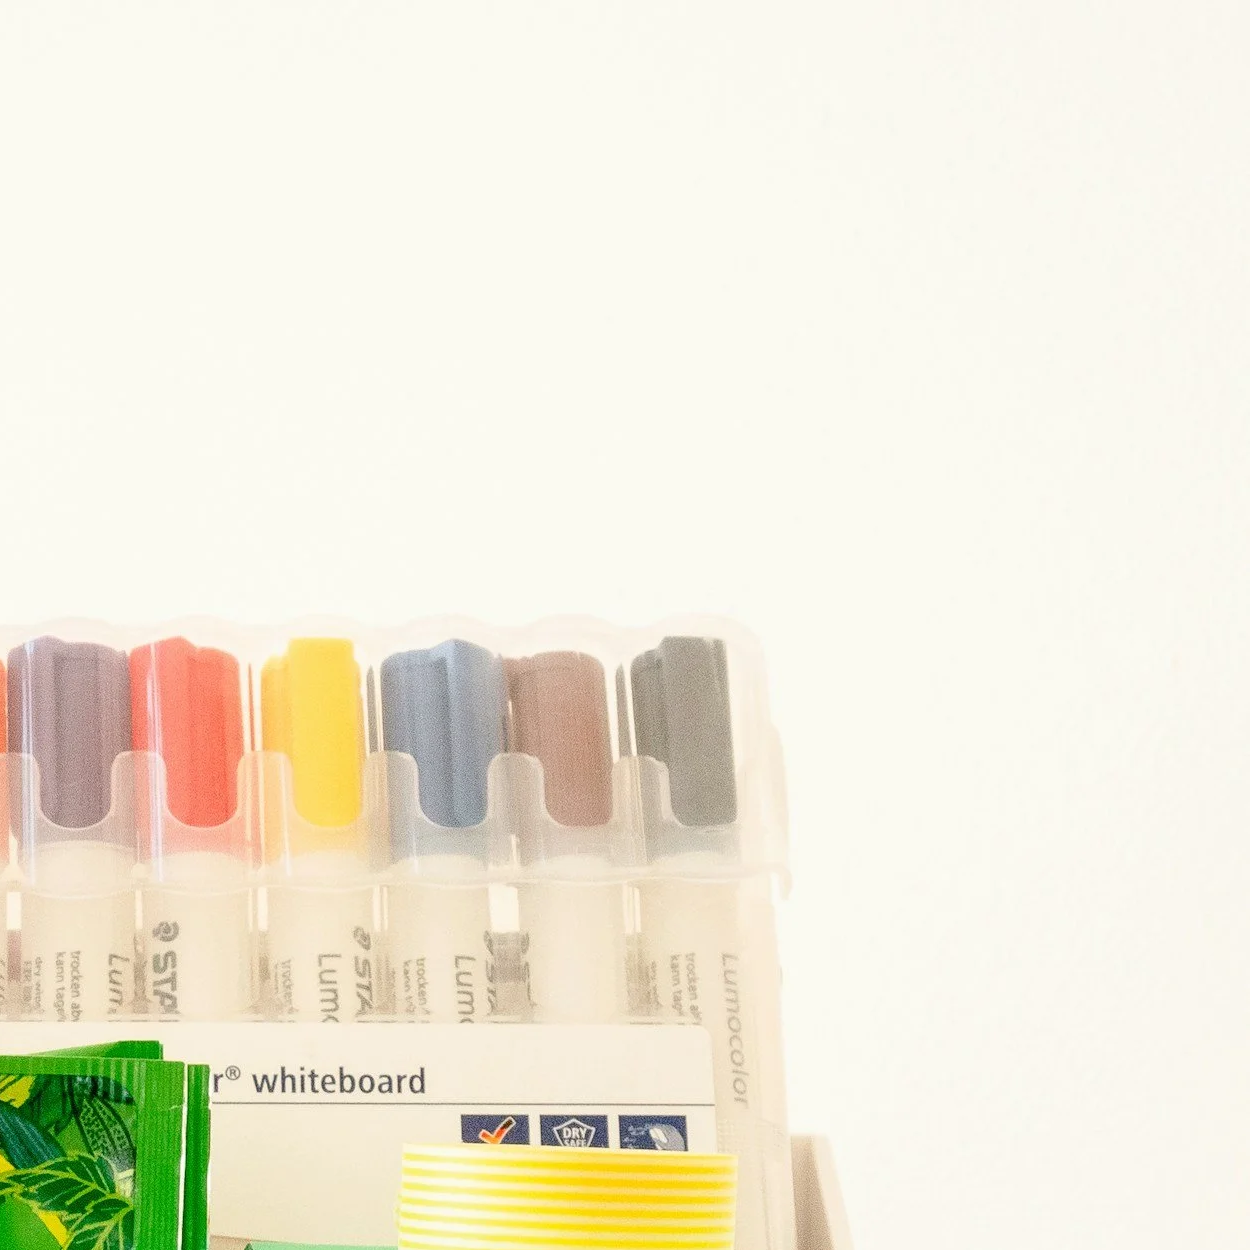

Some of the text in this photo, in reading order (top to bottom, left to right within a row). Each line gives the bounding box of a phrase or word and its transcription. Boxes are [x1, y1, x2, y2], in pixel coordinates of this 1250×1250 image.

[55, 951, 66, 983] kann
[70, 950, 84, 998] trocken
[721, 952, 750, 1108] Lumocolor
[252, 1067, 426, 1094] whiteboard
[562, 1127, 587, 1140] DRY
